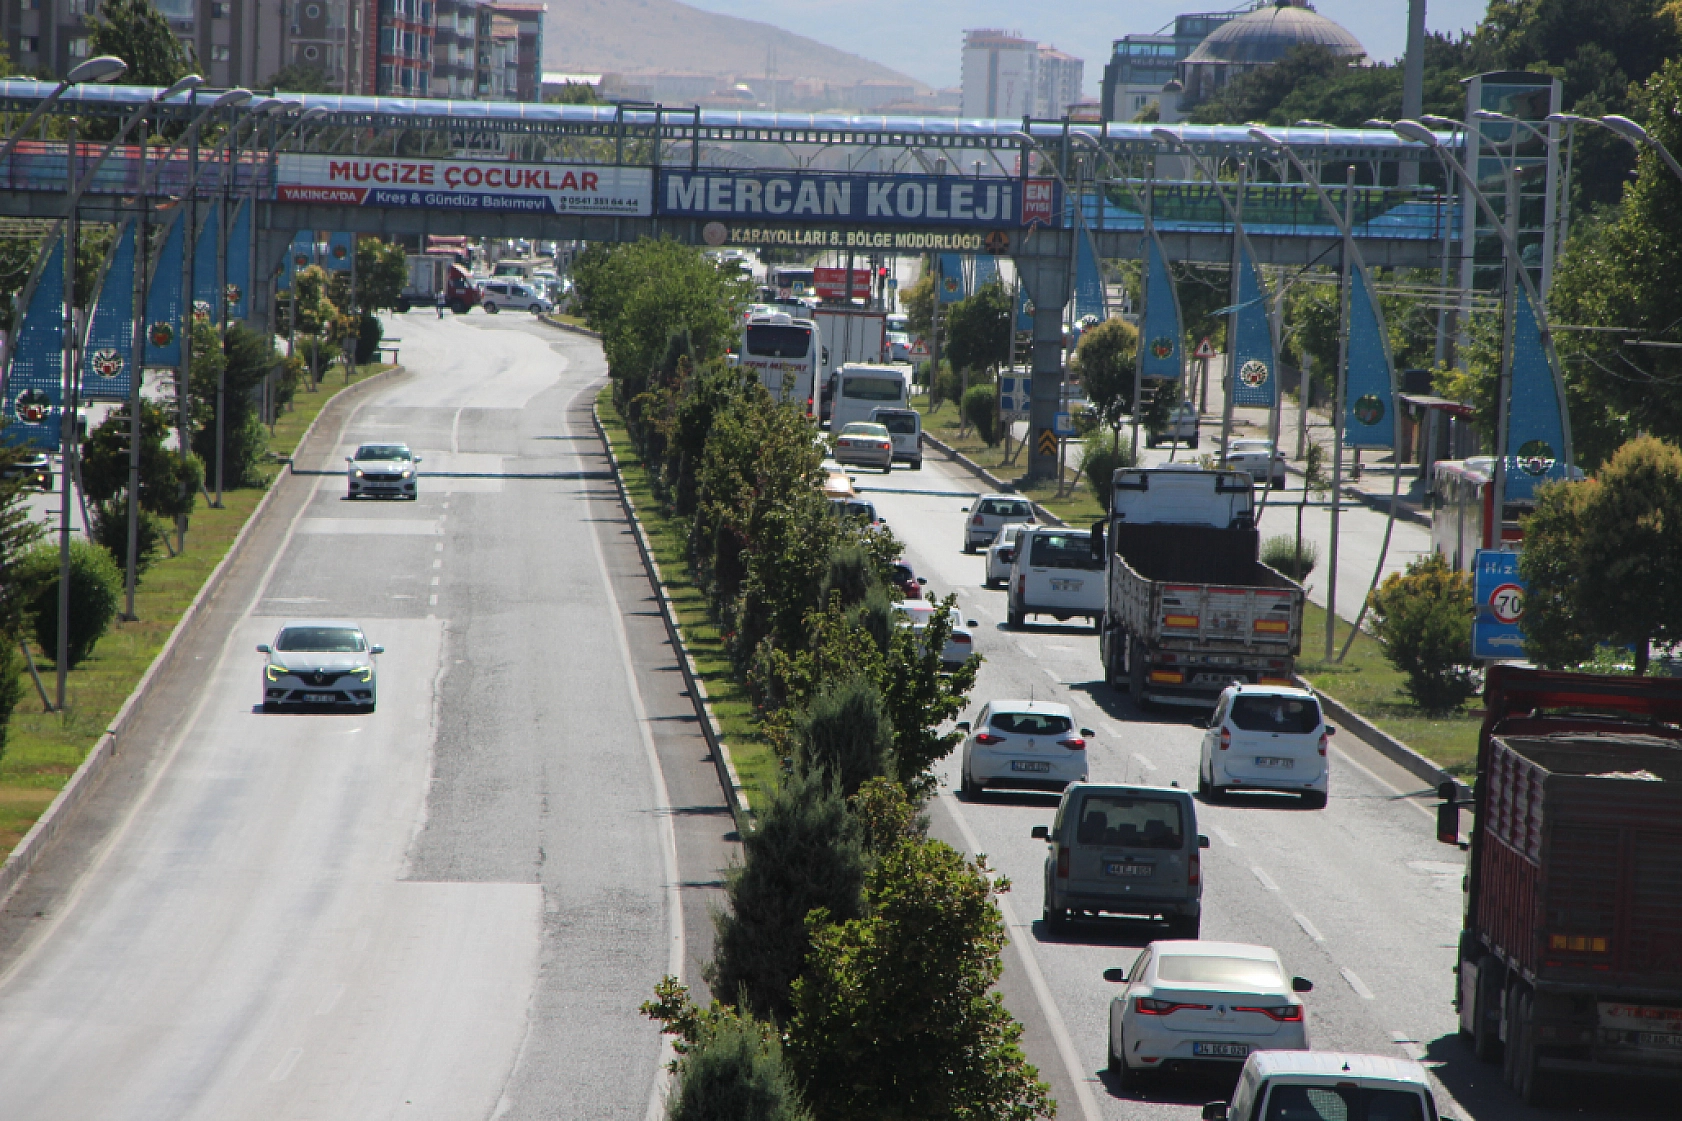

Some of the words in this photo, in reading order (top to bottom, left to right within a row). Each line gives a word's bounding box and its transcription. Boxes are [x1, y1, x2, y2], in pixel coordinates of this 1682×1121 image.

[444, 165, 599, 192] ÇOCUKLAR
[283, 188, 357, 202] YAKINCA'DA
[375, 191, 406, 205] Kreş
[410, 192, 421, 204] &
[424, 193, 478, 207] Gündüz
[666, 174, 851, 215] MERCAN
[1025, 184, 1050, 200] EN
[731, 228, 827, 245] KARAYOLLARI
[830, 230, 842, 246] 8.
[846, 230, 892, 248] BÖLGE
[1498, 595, 1521, 614] 70
